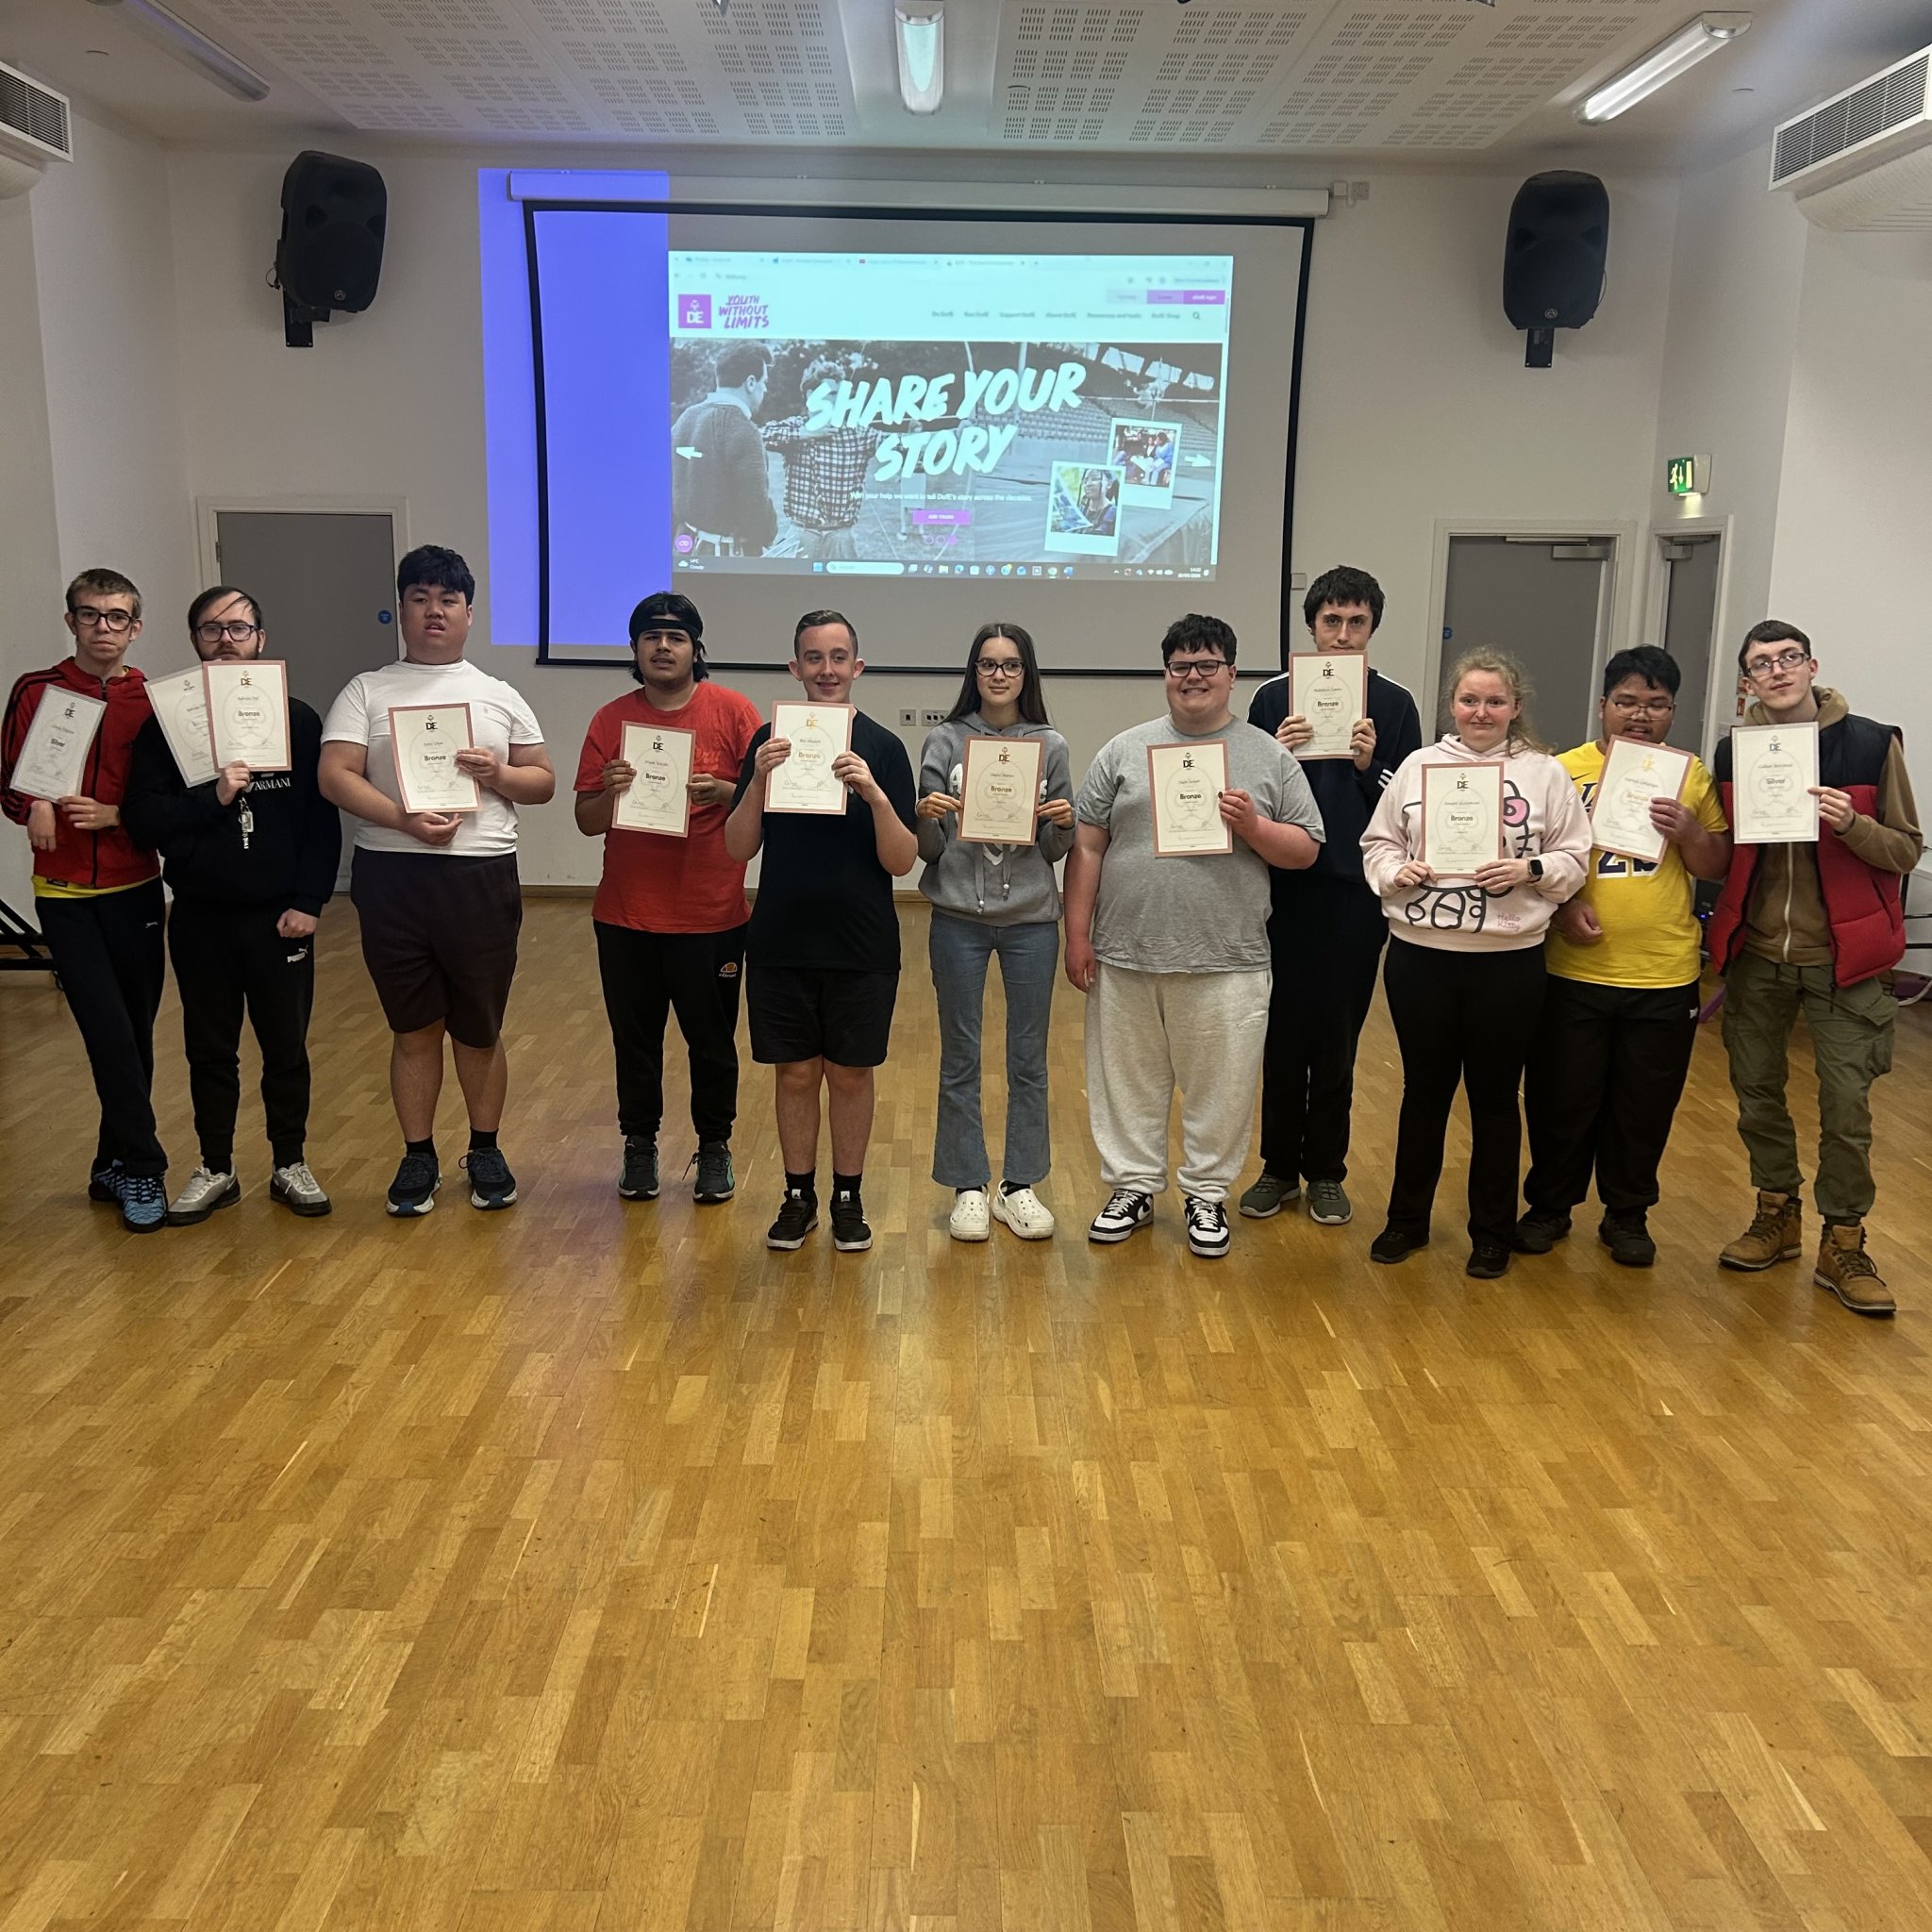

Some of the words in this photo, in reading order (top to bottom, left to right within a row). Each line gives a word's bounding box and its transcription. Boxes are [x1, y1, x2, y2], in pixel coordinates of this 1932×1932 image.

[725, 295, 759, 305] YOUTH
[719, 305, 768, 316] WITHOUT
[724, 315, 769, 329] LIMITS
[806, 373, 956, 433] SHARE
[957, 362, 1087, 419] YOUR
[874, 425, 1018, 482] STORY
[879, 492, 892, 501] help
[645, 773, 665, 781] Bronze
[255, 777, 291, 791] ARMANI
[1498, 913, 1521, 922] Hello
[1497, 921, 1522, 932] Kitty
